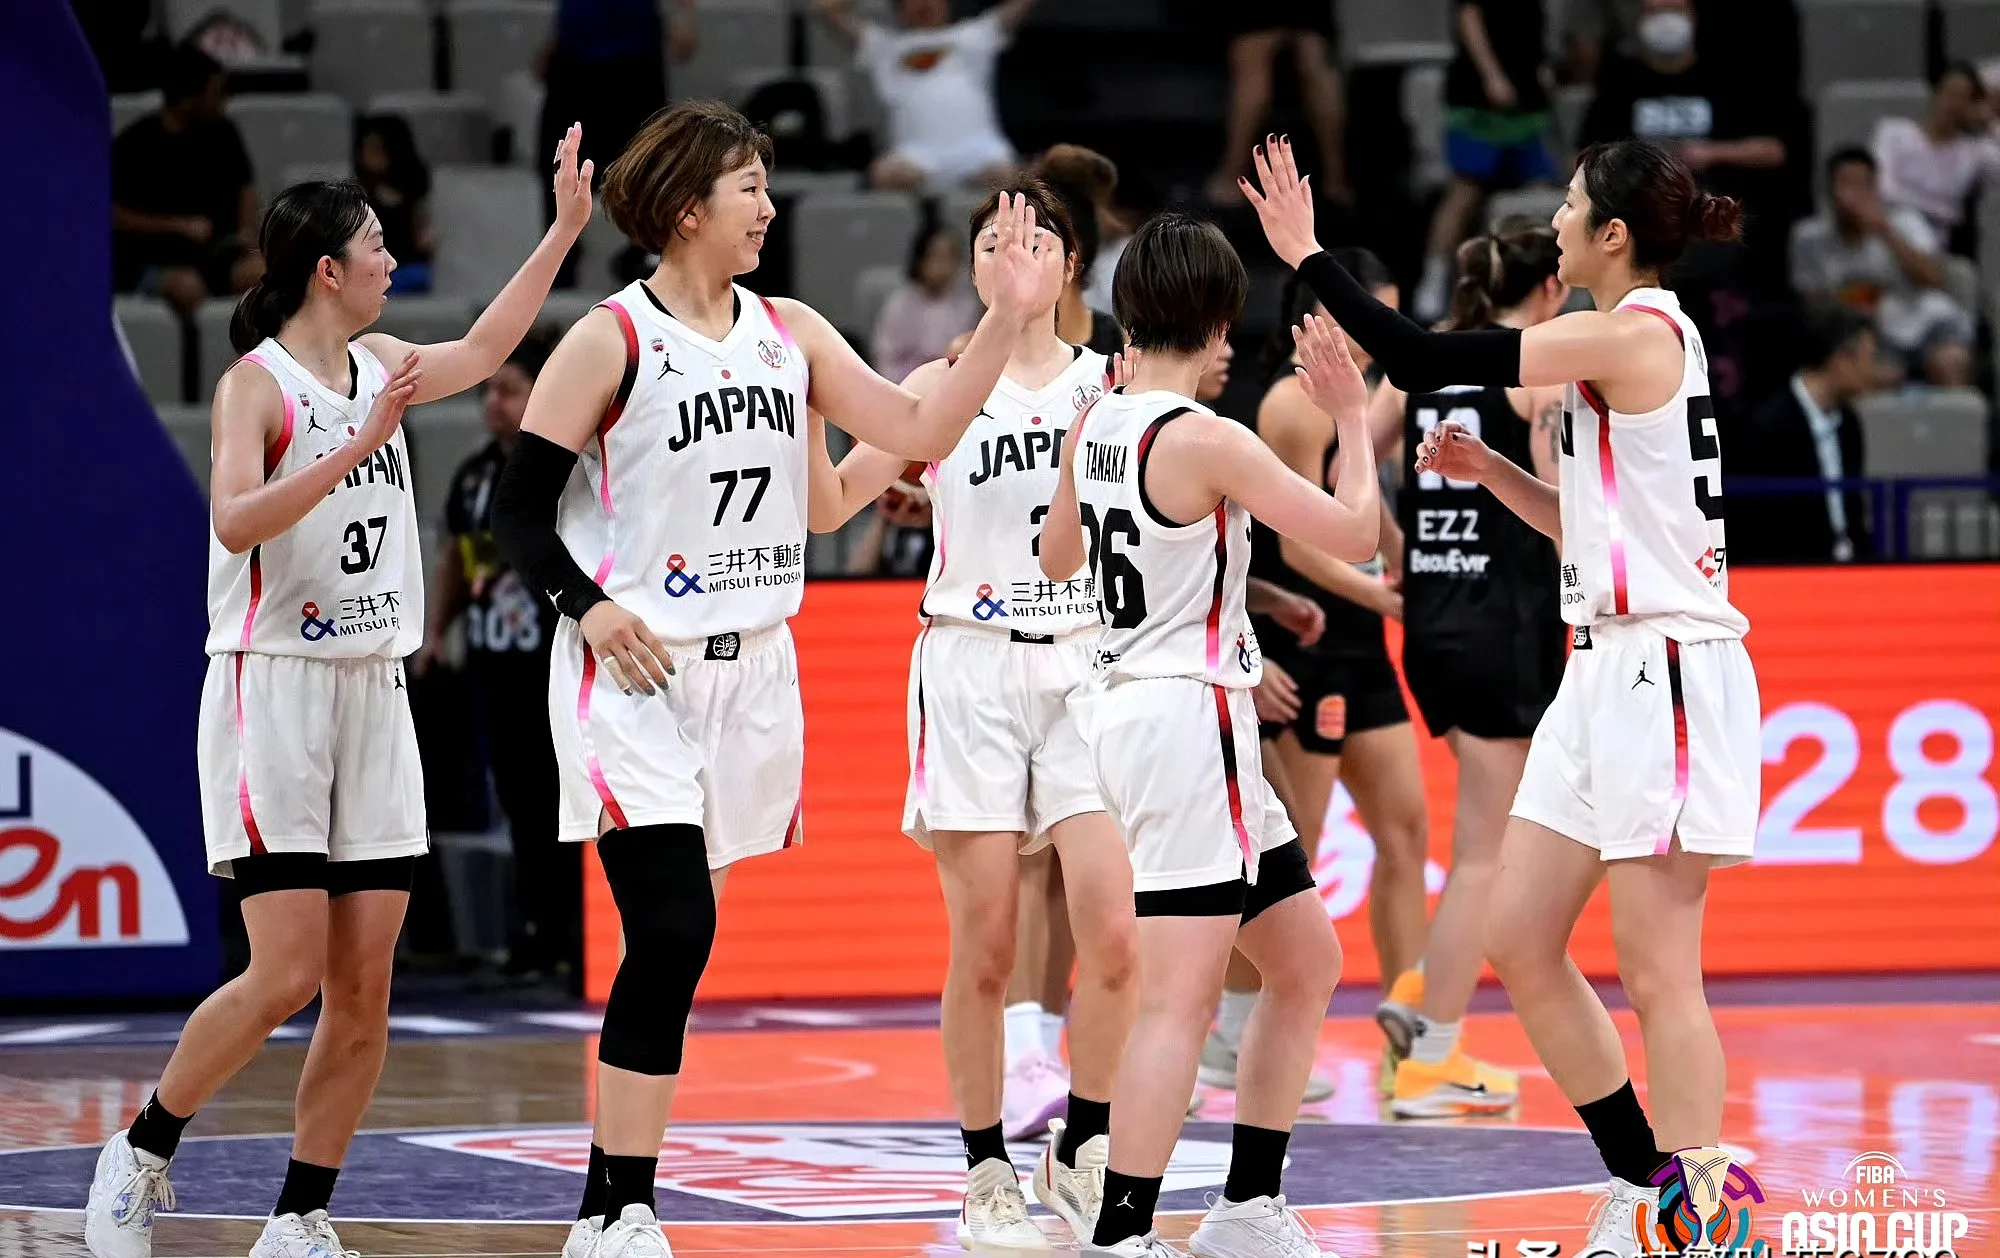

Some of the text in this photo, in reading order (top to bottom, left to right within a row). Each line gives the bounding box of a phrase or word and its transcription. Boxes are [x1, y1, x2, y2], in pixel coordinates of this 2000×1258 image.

[668, 386, 795, 453] JAPAN
[1086, 441, 1128, 484] TANAKA
[709, 466, 771, 527] 77
[340, 515, 388, 575] 37
[708, 577, 750, 594] MITSUI
[340, 617, 388, 637] MITSUI
[1011, 605, 1061, 617] MITSUI
